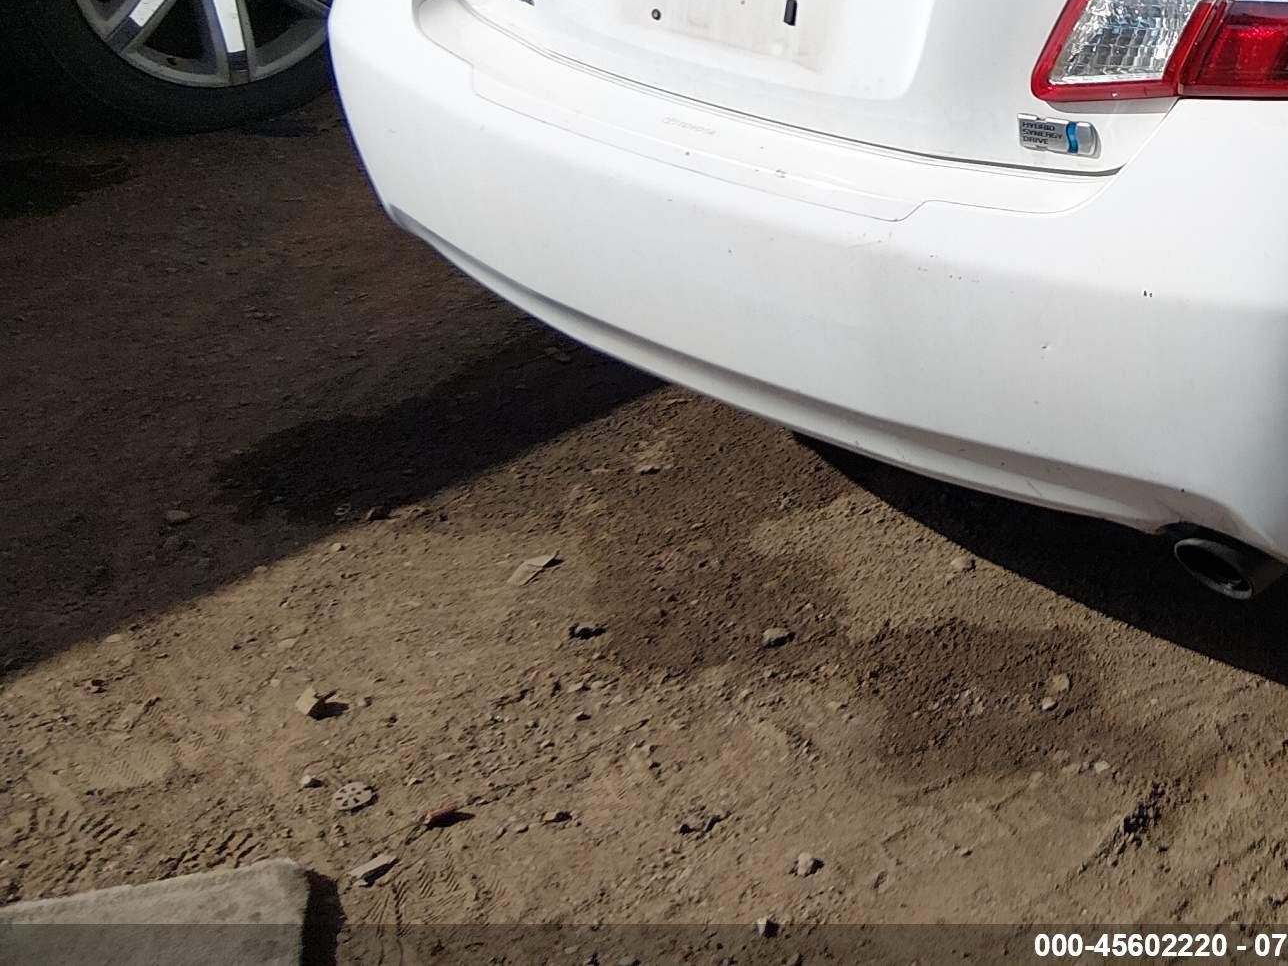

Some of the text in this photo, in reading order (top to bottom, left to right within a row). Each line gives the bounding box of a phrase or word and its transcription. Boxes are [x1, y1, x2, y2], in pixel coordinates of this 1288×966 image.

[1022, 121, 1056, 132] HYBRID
[1022, 128, 1063, 140] SYNERGY
[1023, 136, 1049, 145] DRIVE
